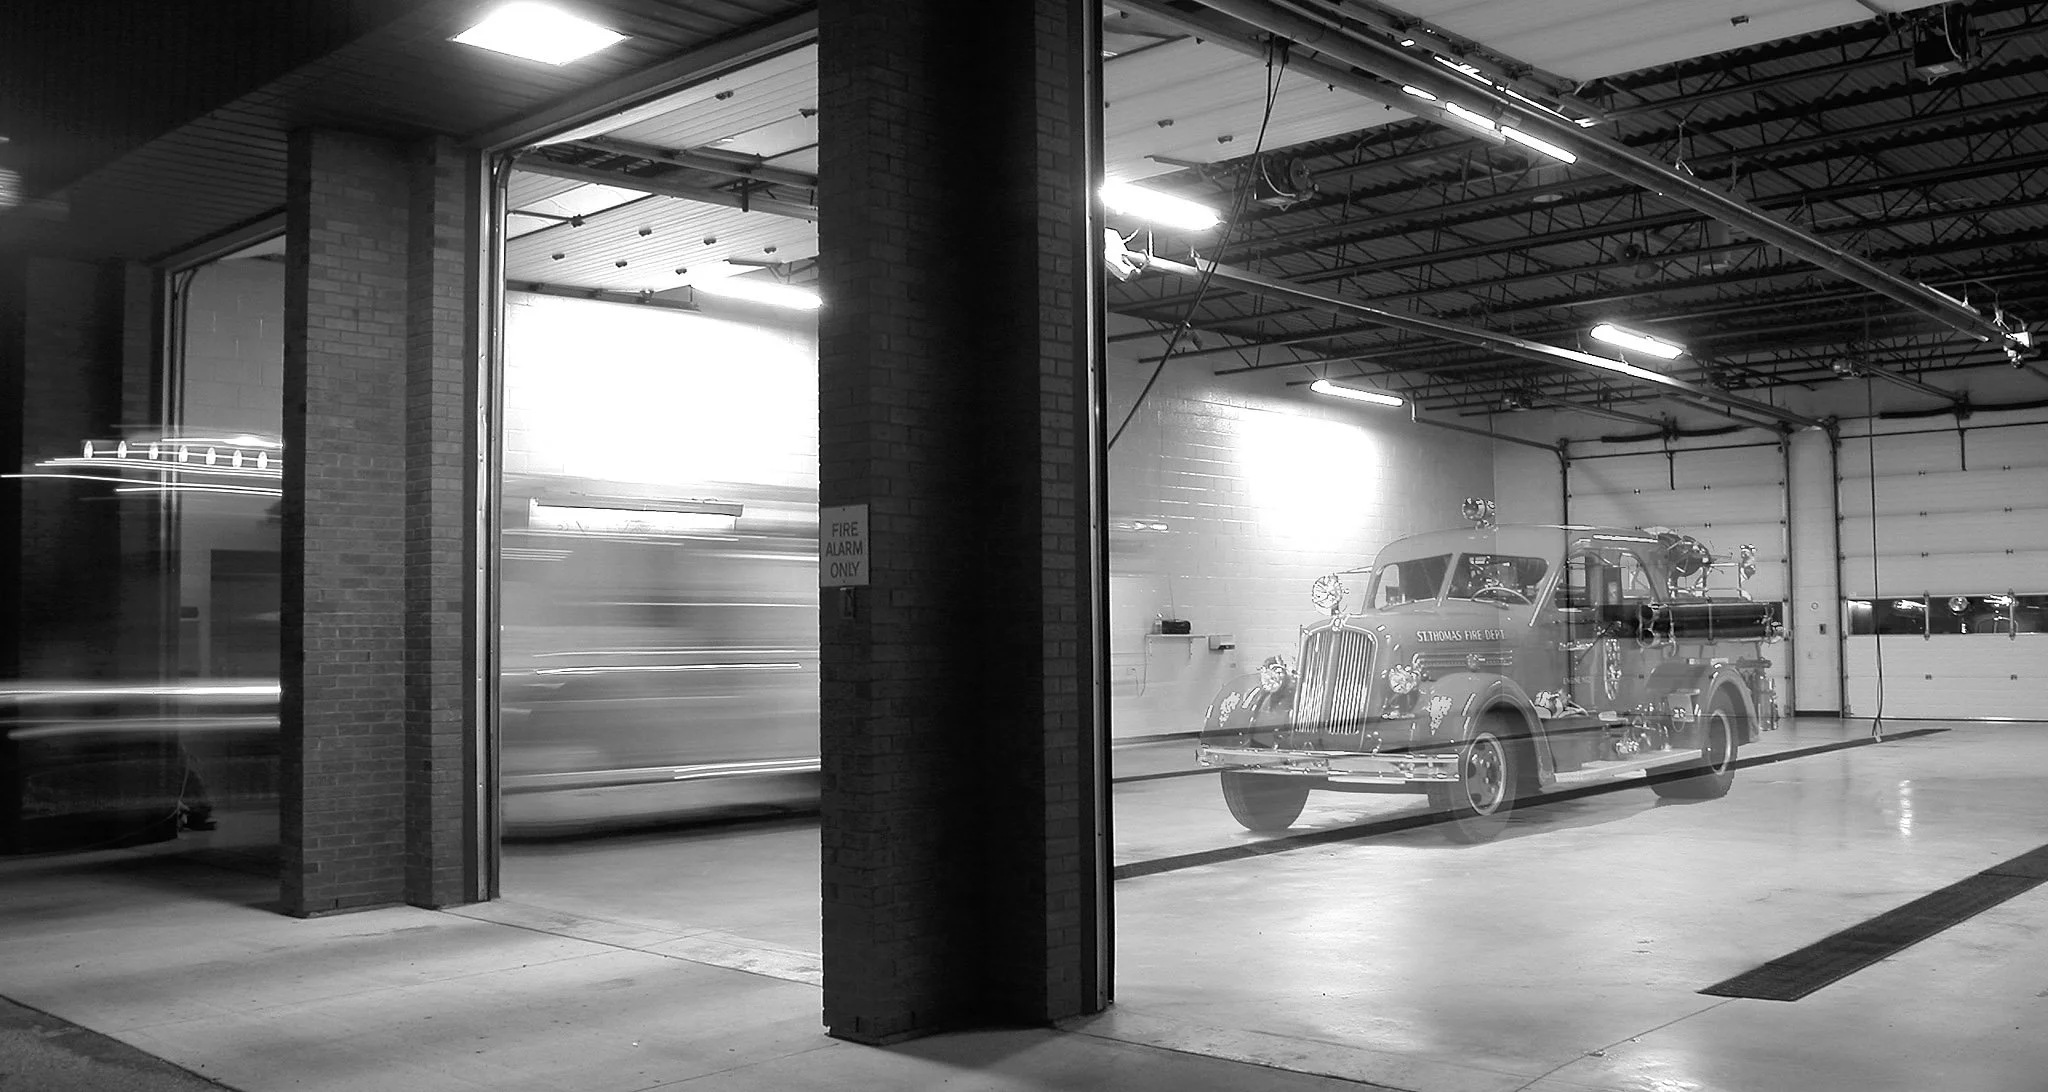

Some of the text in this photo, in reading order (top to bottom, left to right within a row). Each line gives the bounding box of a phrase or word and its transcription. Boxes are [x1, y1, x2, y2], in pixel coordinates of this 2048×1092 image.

[832, 521, 858, 537] FIRE
[825, 540, 863, 557] ALARM
[830, 561, 860, 578] ONLY
[1464, 630, 1482, 641] FIRE
